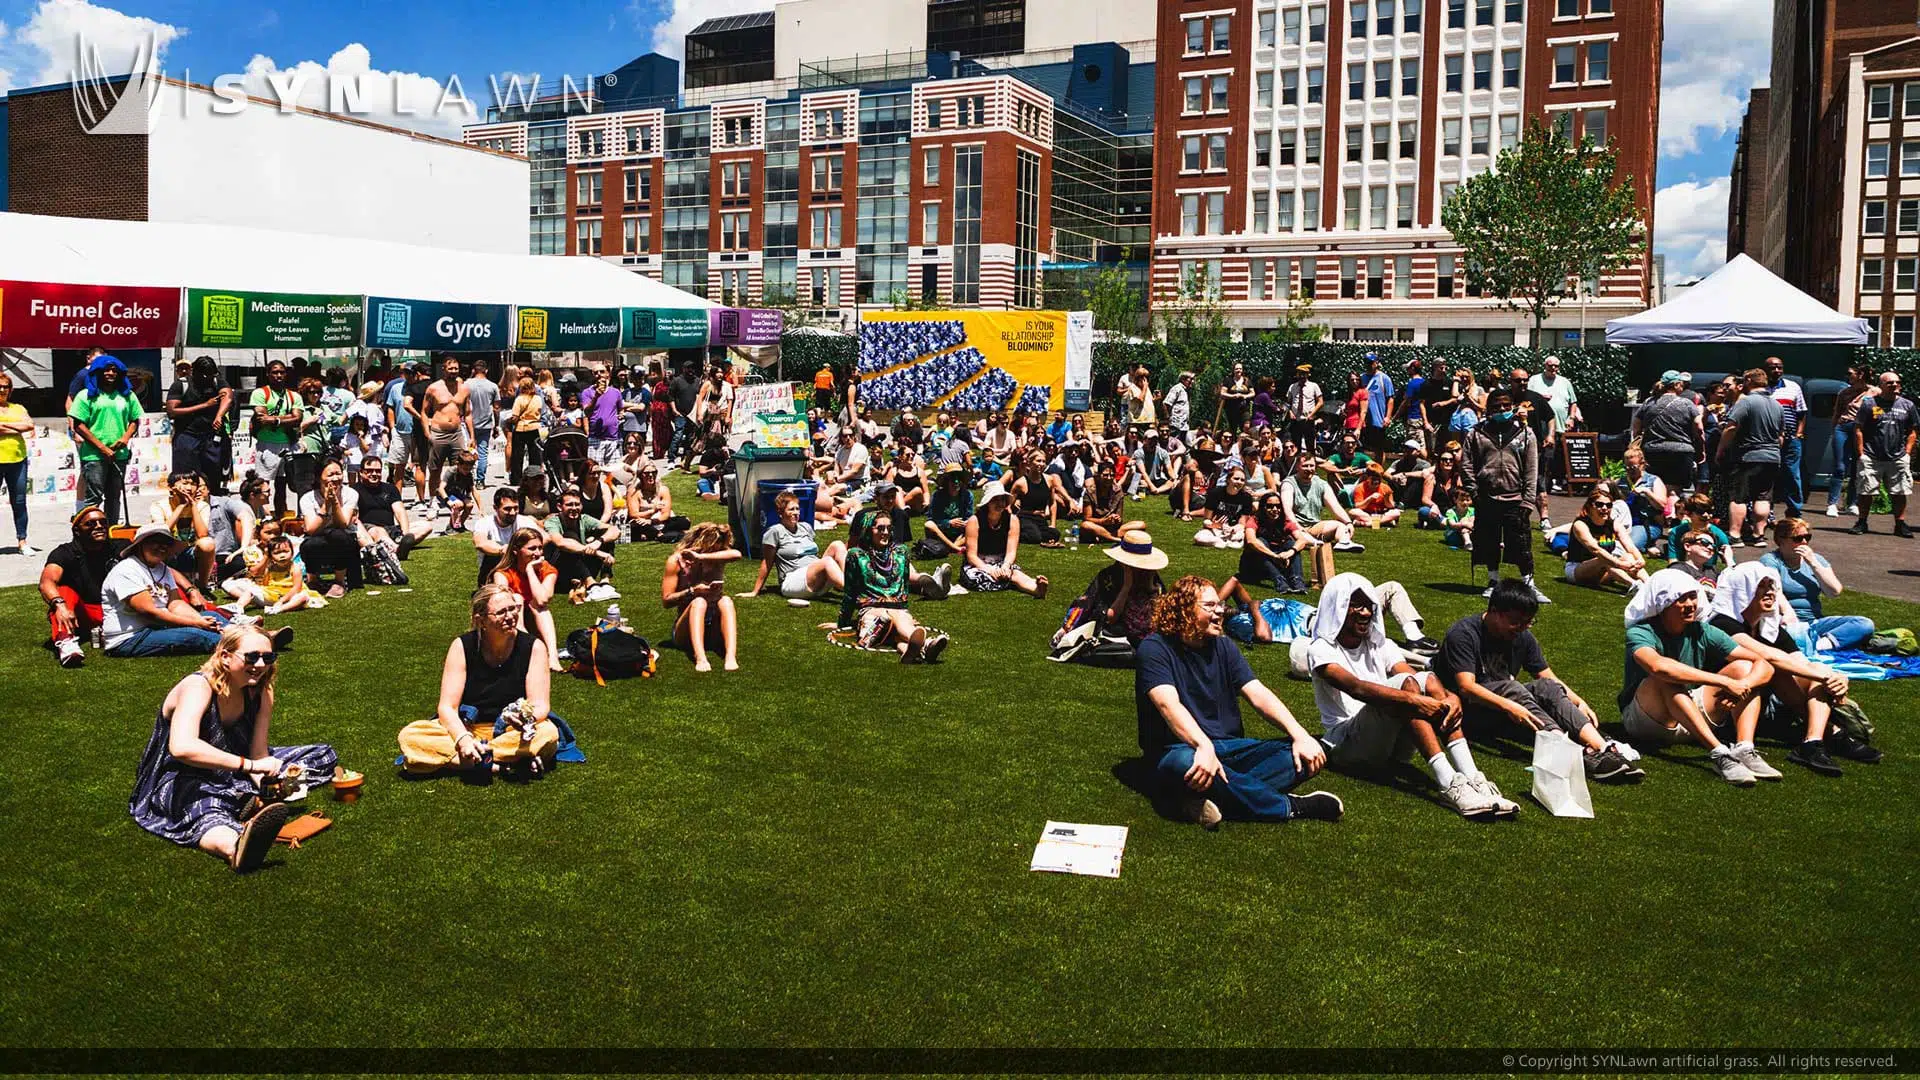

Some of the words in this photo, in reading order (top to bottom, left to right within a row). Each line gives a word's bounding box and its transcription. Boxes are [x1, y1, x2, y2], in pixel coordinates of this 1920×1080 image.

[30, 299, 103, 318] Funnel
[110, 302, 161, 319] Cakes
[251, 301, 325, 314] Mediterranean
[326, 303, 361, 315] Specialties
[210, 317, 237, 325] ARTS
[278, 316, 300, 324] Falafel
[384, 321, 405, 329] ARTS
[1026, 321, 1033, 330] IS
[1034, 320, 1054, 330] YOUR
[60, 322, 97, 335] Fried
[101, 323, 139, 335] Oreos
[266, 325, 287, 333] Grape
[288, 325, 310, 333] Leaves
[436, 315, 492, 344] Gyros
[559, 322, 597, 334] Helmut's
[598, 322, 618, 334] Strudel
[274, 334, 302, 342] Hummus
[1001, 331, 1054, 341] RELATIONSHIP
[1007, 341, 1054, 351] BLOOMING?
